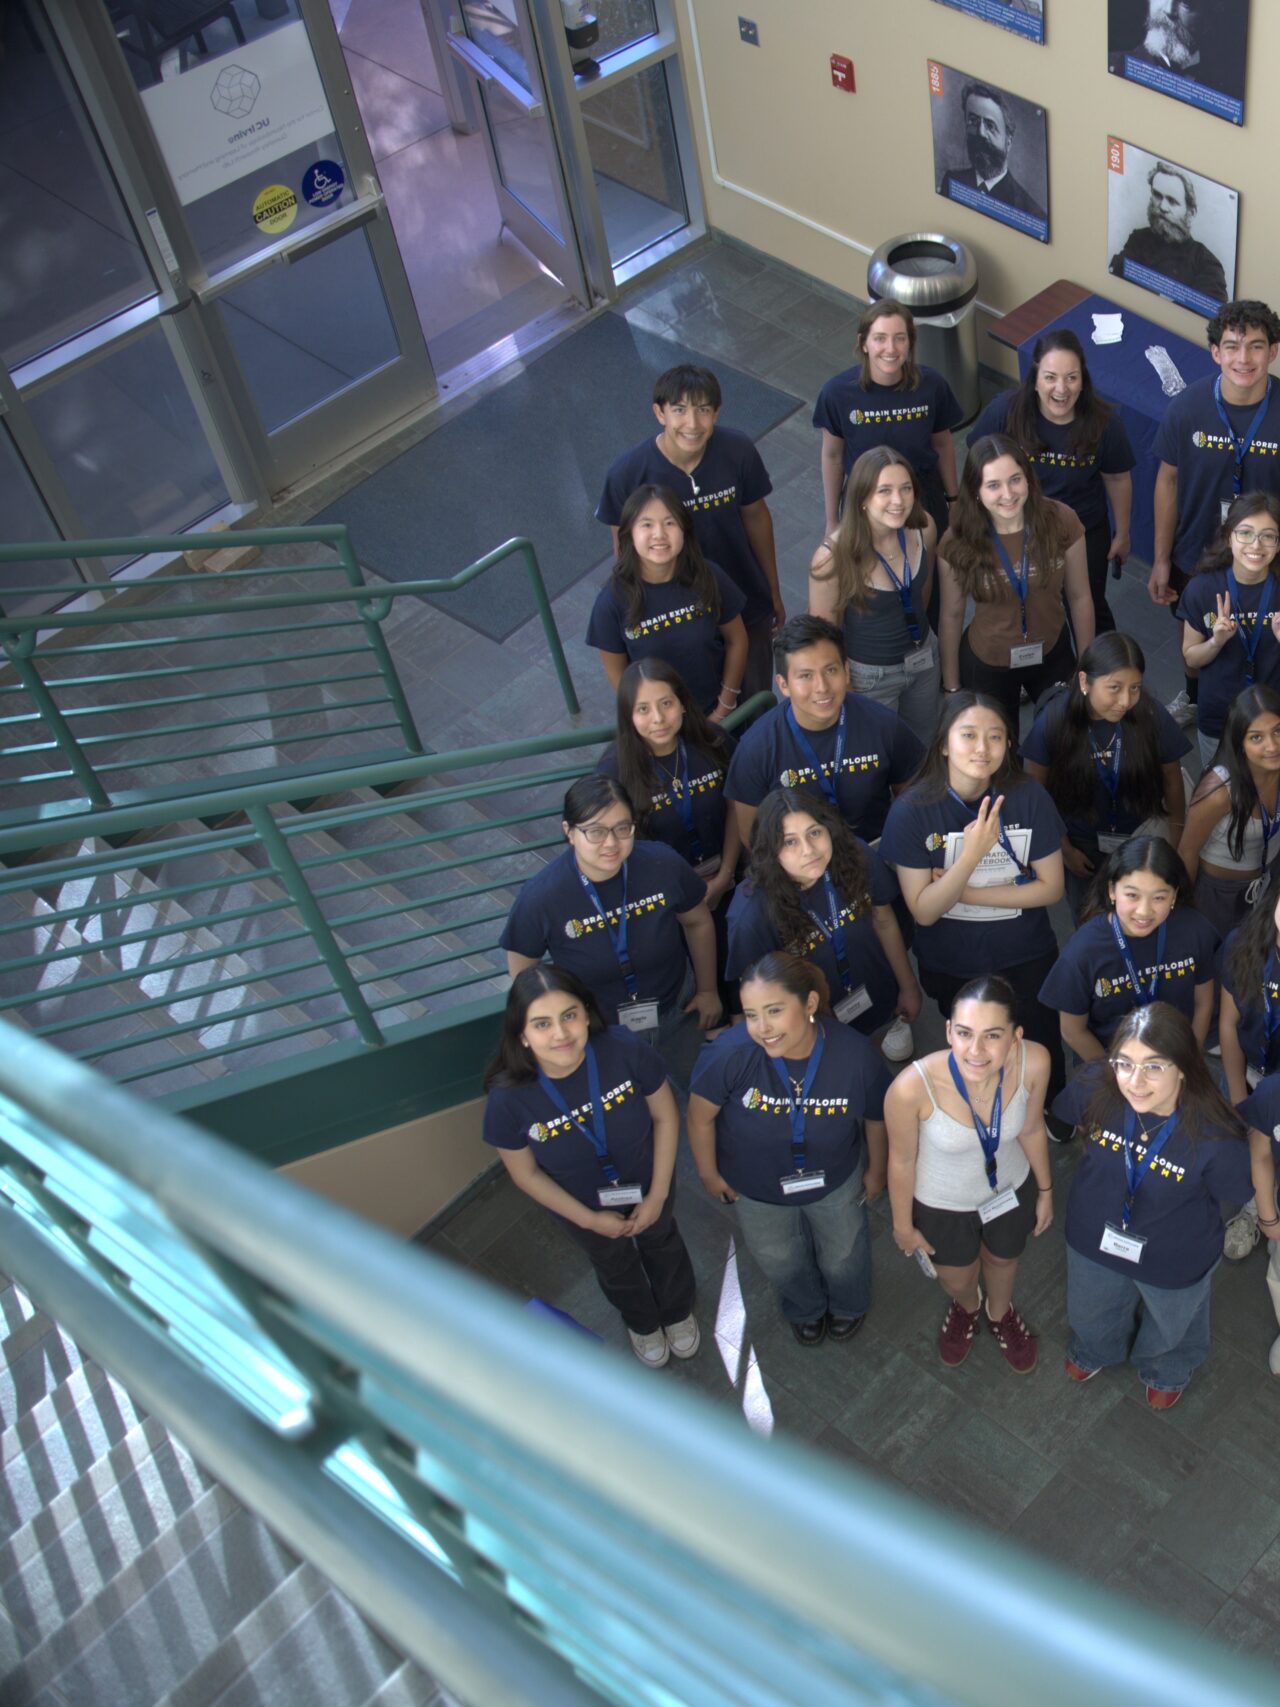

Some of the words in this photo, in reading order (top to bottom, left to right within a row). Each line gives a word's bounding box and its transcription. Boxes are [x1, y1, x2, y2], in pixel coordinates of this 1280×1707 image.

[256, 190, 290, 211] AUTOMATIC
[255, 195, 296, 222] CAUTION
[864, 409, 890, 418] BRAIN
[1207, 442, 1278, 455] ACAEMY
[641, 613, 667, 628] BRAIN
